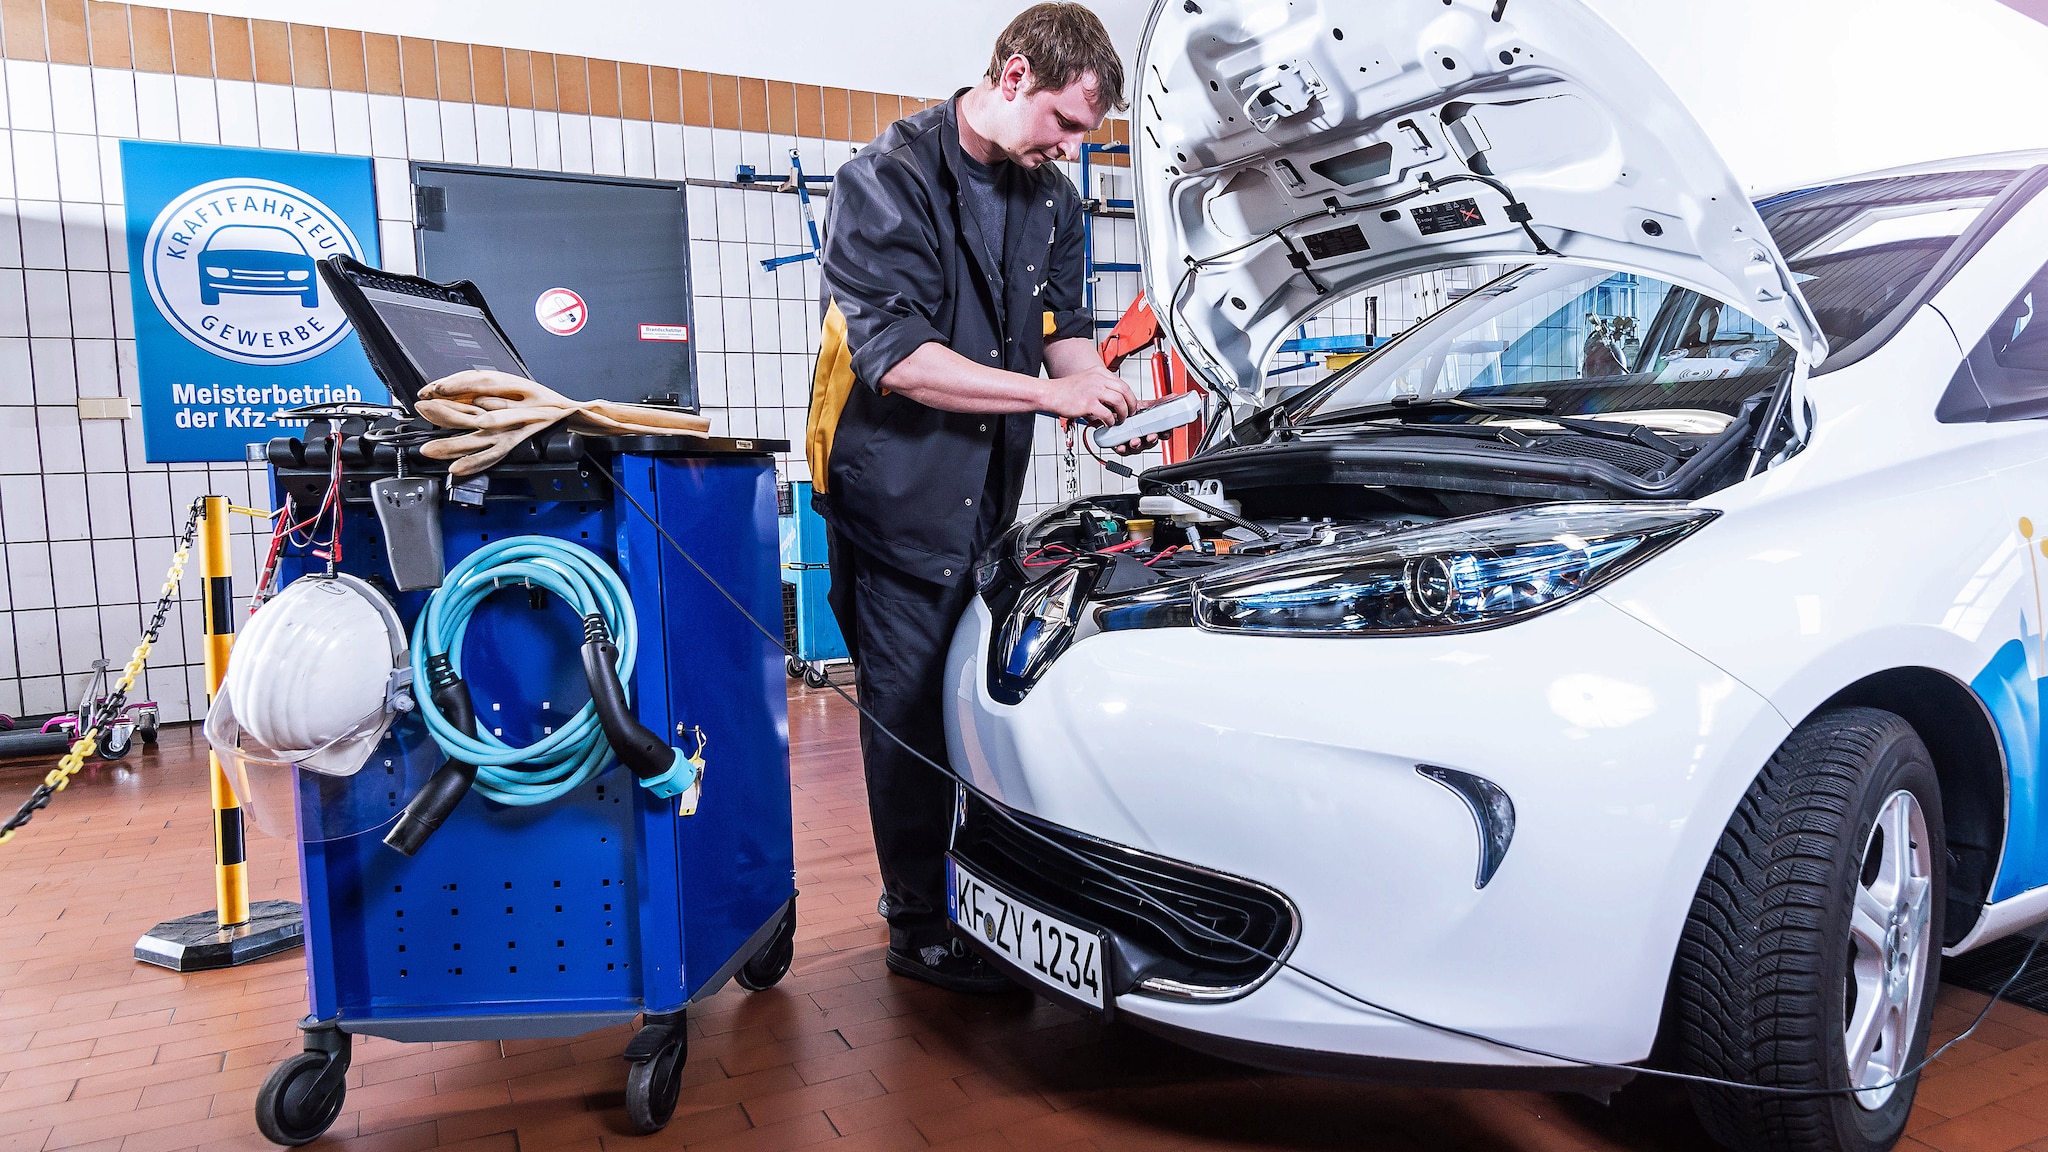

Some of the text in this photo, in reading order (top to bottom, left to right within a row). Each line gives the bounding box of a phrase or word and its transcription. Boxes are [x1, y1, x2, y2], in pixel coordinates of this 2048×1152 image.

[167, 196, 338, 260] KRAFTFAHRZEU
[201, 315, 325, 348] GEWERBE
[172, 382, 362, 404] Meisterbetrieb
[175, 408, 217, 428] der
[958, 872, 1099, 998] KF ZY 1234
